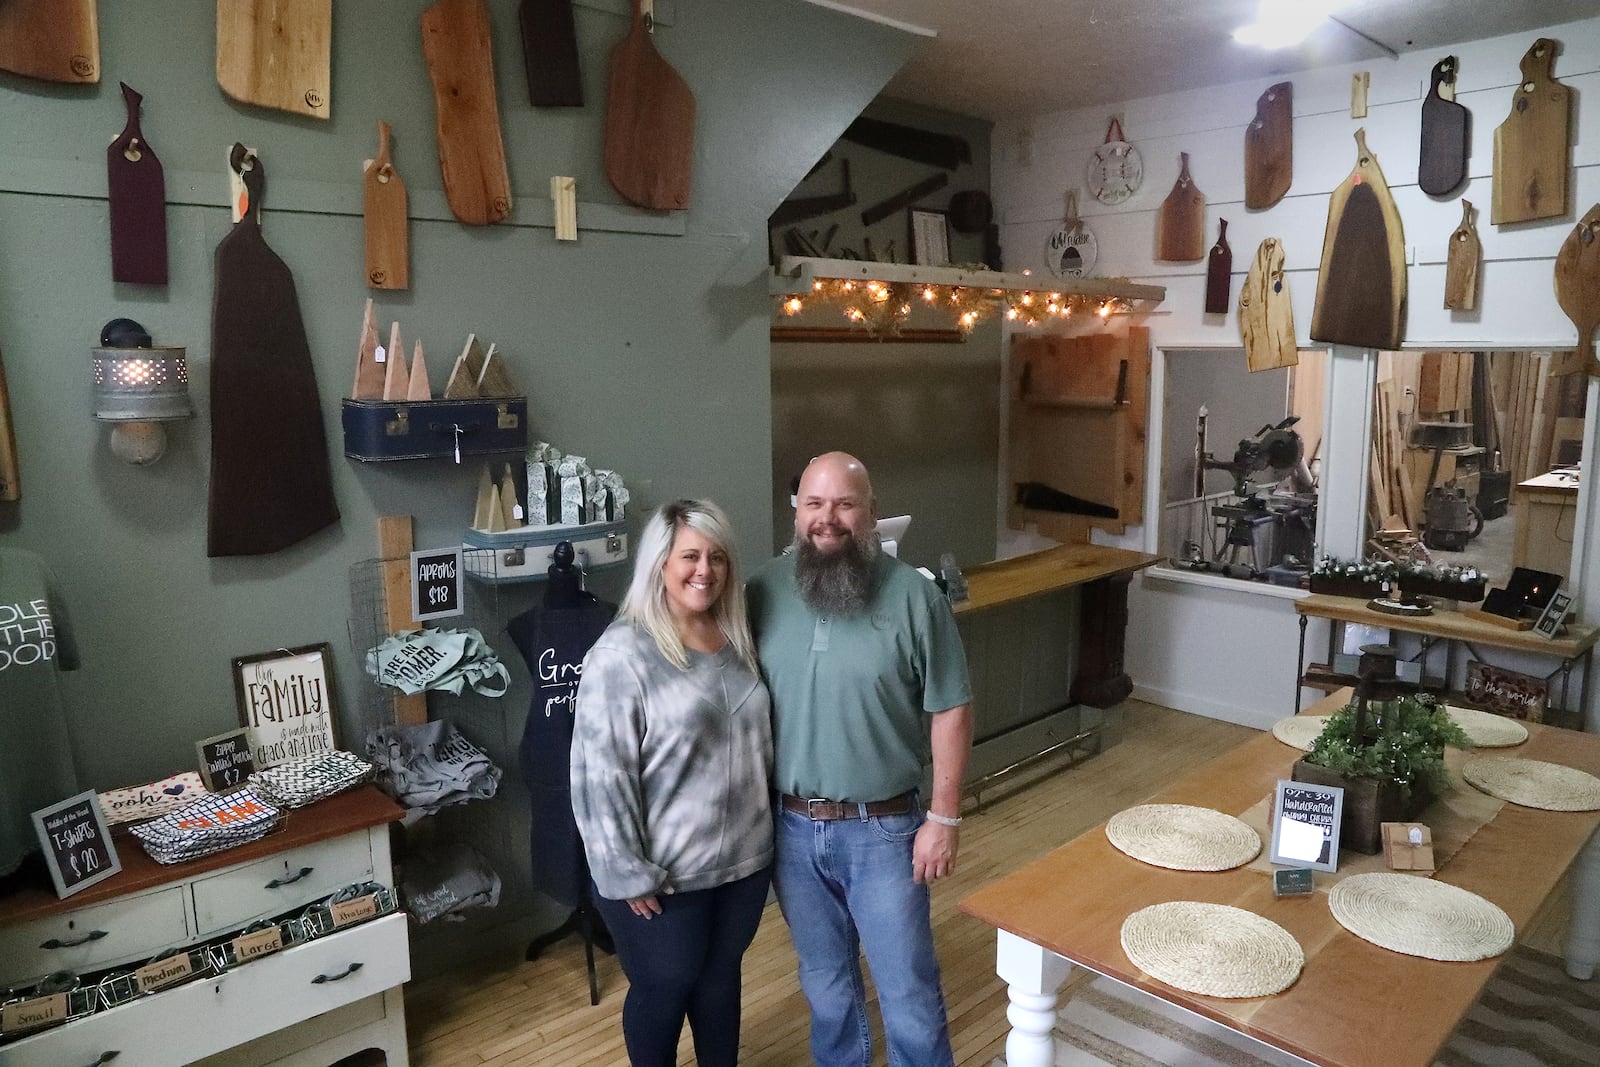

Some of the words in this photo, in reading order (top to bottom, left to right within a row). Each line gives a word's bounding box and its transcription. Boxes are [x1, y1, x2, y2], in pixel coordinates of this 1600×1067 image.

[428, 585, 449, 606] $18
[1470, 677, 1481, 690] To
[1485, 681, 1504, 696] the
[1506, 691, 1537, 707] world
